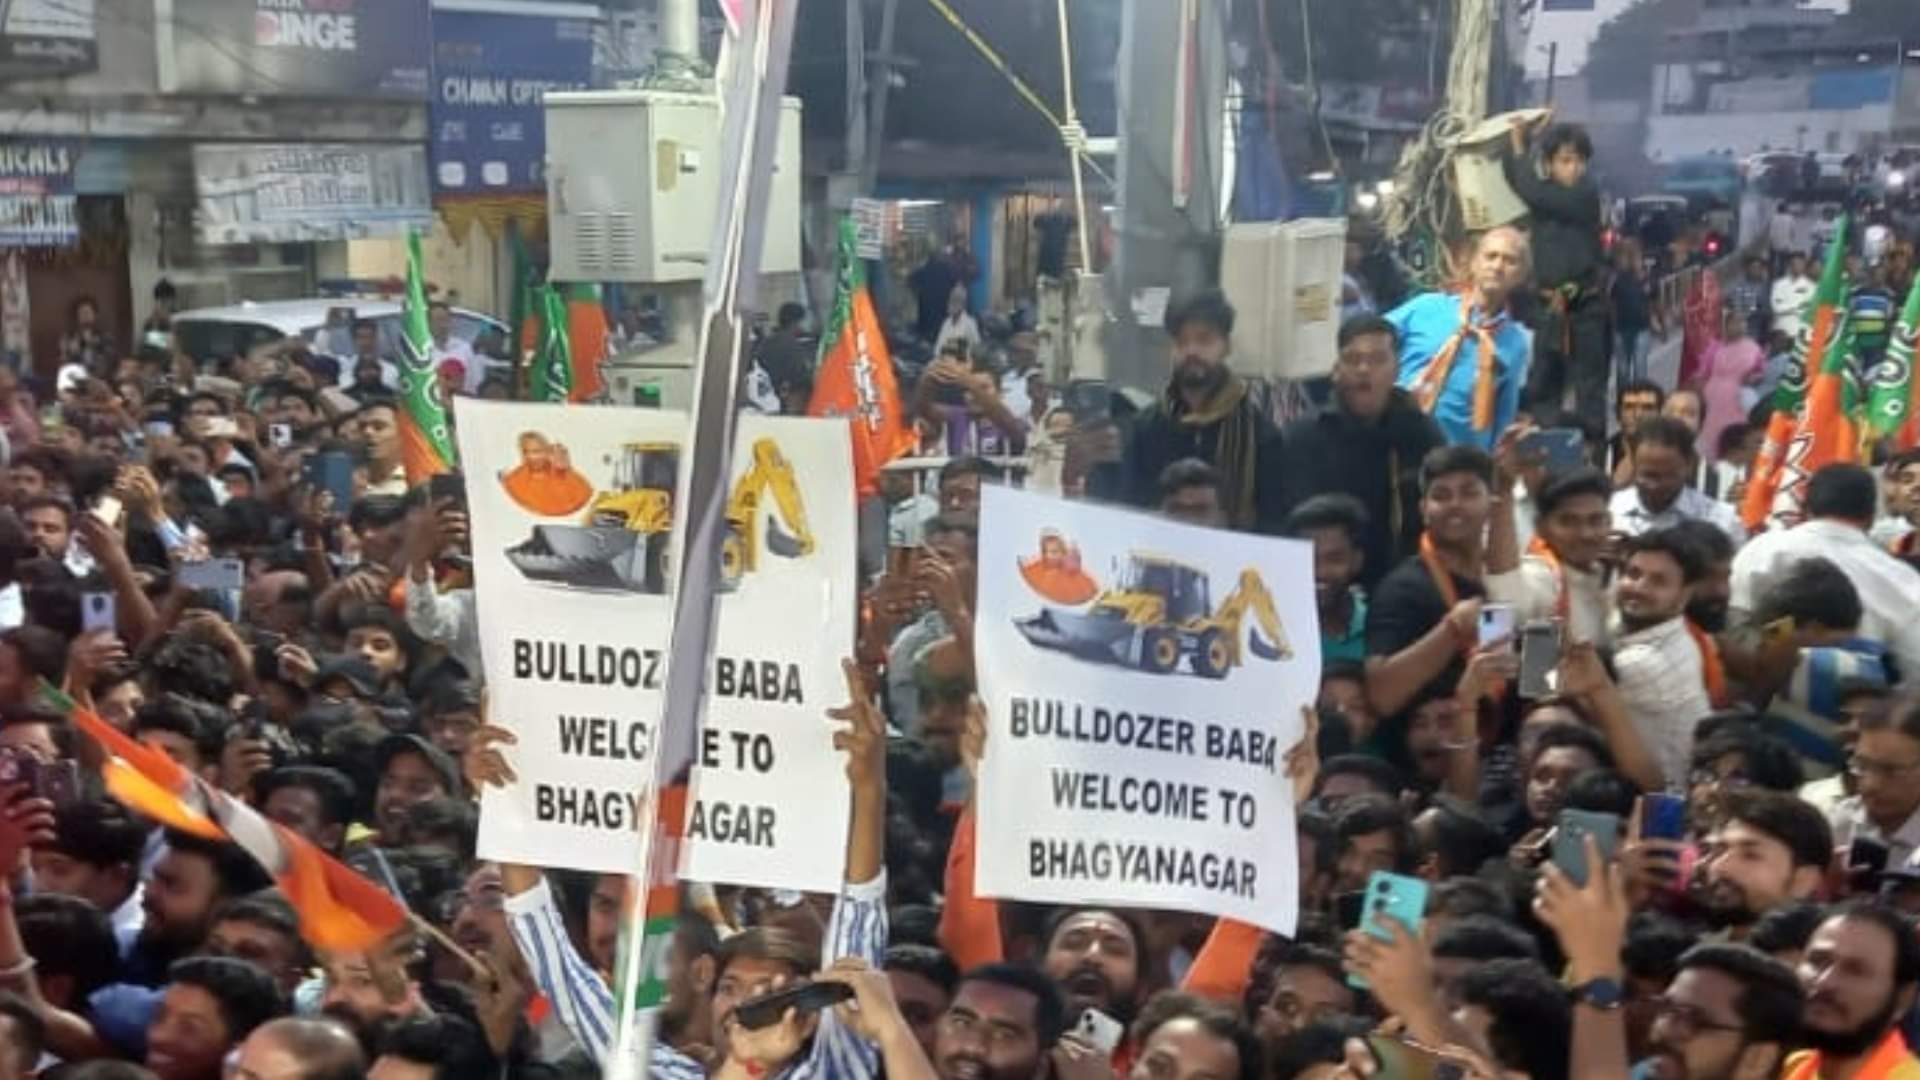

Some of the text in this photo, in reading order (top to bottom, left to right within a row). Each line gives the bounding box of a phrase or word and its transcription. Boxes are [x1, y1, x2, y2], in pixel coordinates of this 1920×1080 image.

[513, 637, 804, 704] BULLDOZ BABA
[558, 713, 775, 773] WELCE TO
[1010, 697, 1277, 774] BULLDOZER BABA
[535, 783, 776, 848] BHAGYAGAR
[1052, 767, 1257, 829] WELCOME TO
[1029, 838, 1258, 899] BHAGYANAGAR
